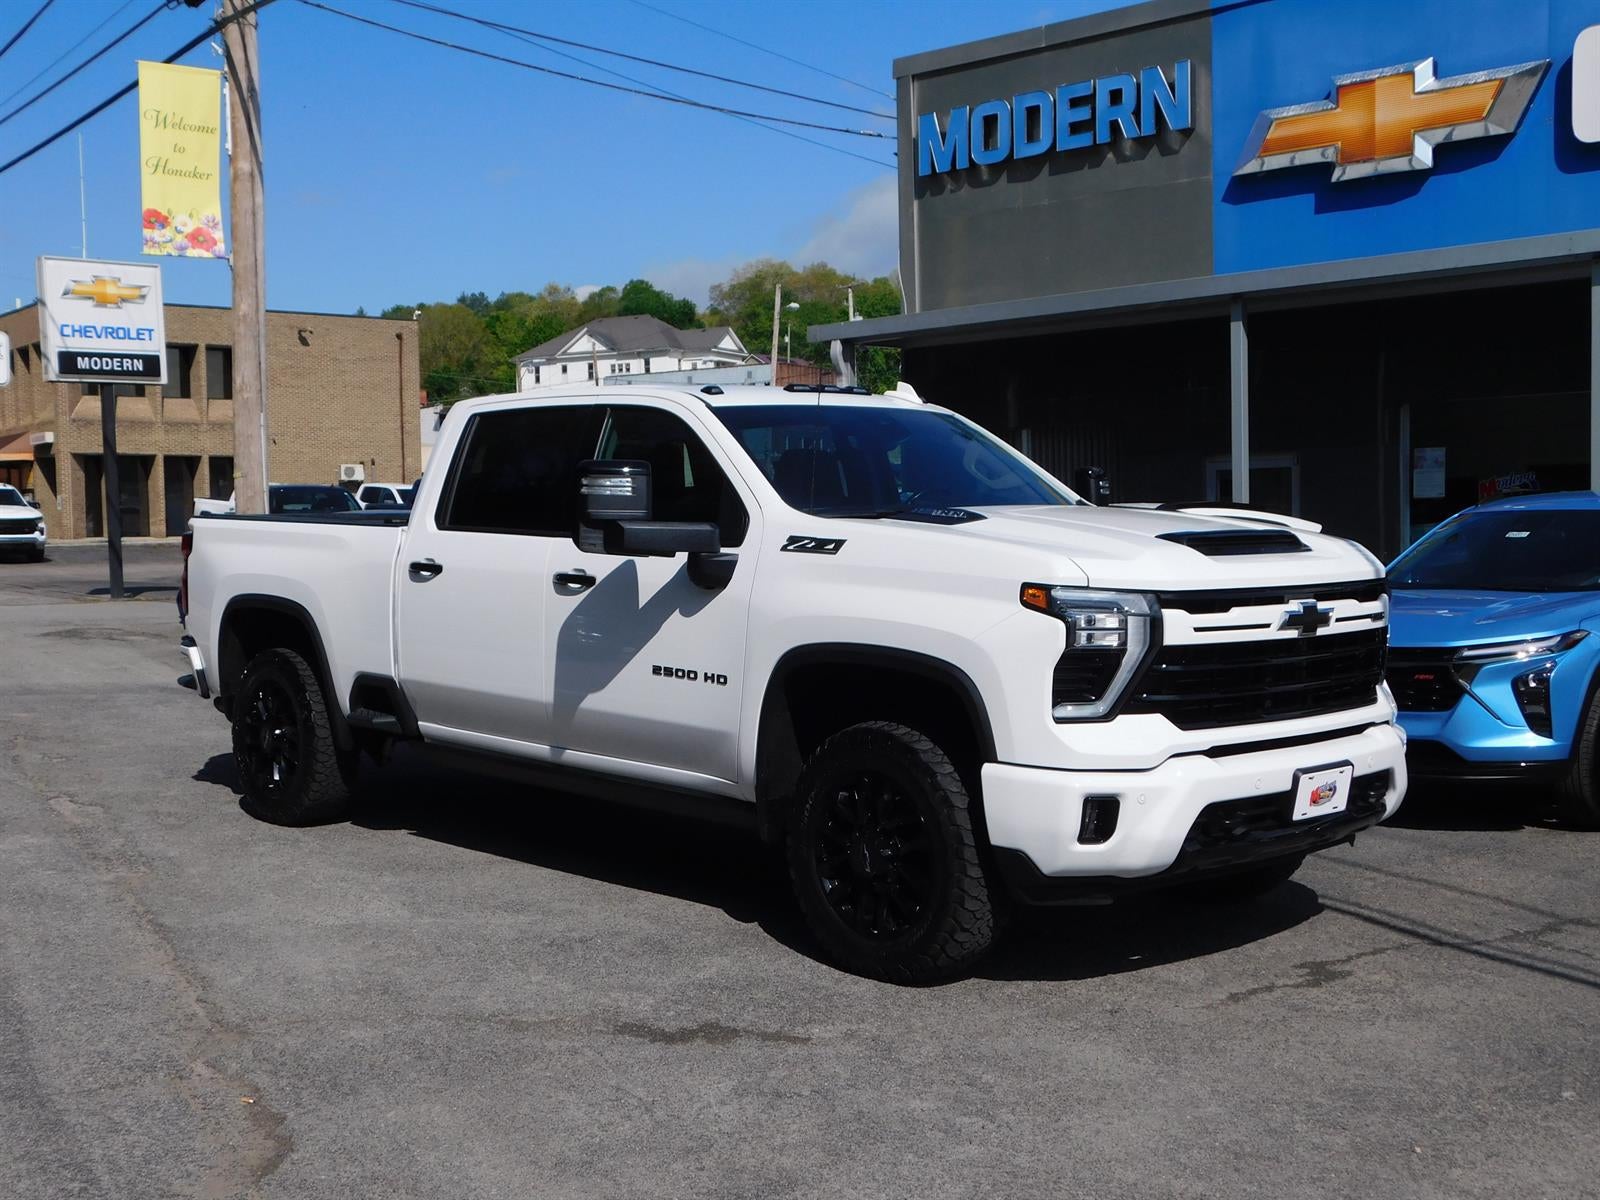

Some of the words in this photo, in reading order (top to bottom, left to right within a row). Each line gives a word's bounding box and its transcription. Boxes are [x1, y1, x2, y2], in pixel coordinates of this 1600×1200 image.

[144, 109, 217, 134] Welcome
[918, 59, 1191, 176] MODERN
[173, 143, 186, 153] to
[145, 156, 213, 180] Honaker
[60, 324, 155, 341] CHEVROLET
[77, 357, 143, 371] MODERN
[652, 665, 698, 681] 2500
[704, 672, 728, 686] HD
